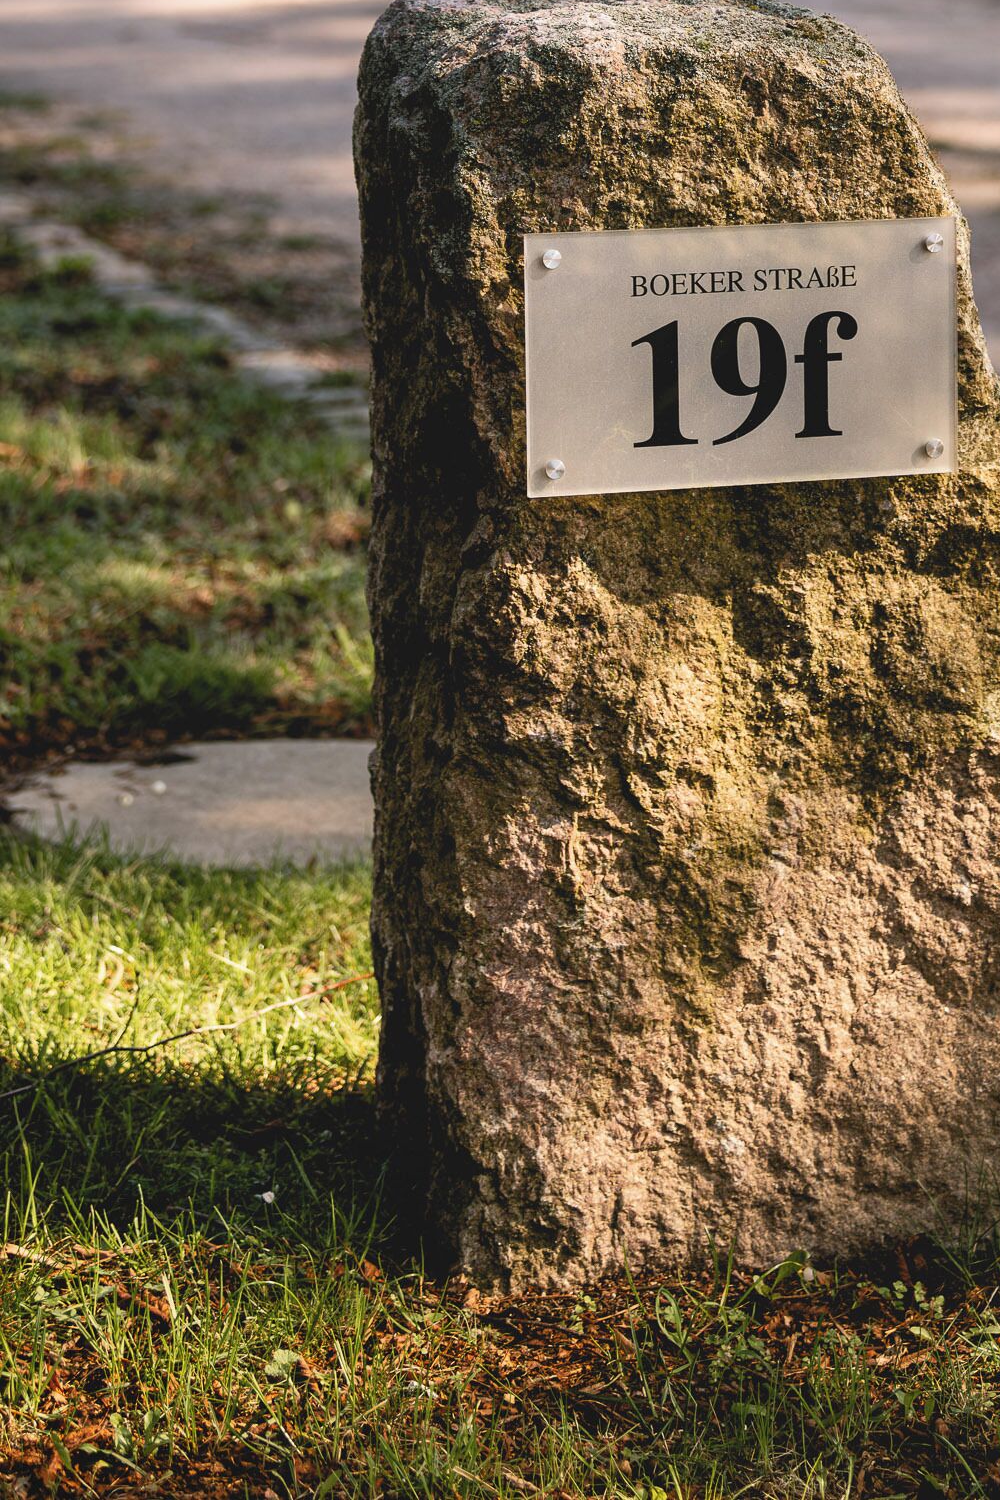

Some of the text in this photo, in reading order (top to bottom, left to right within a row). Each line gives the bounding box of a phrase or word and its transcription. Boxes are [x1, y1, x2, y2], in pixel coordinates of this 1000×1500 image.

[631, 266, 856, 297] BOEKER STRAßE
[631, 311, 857, 448] 19f
